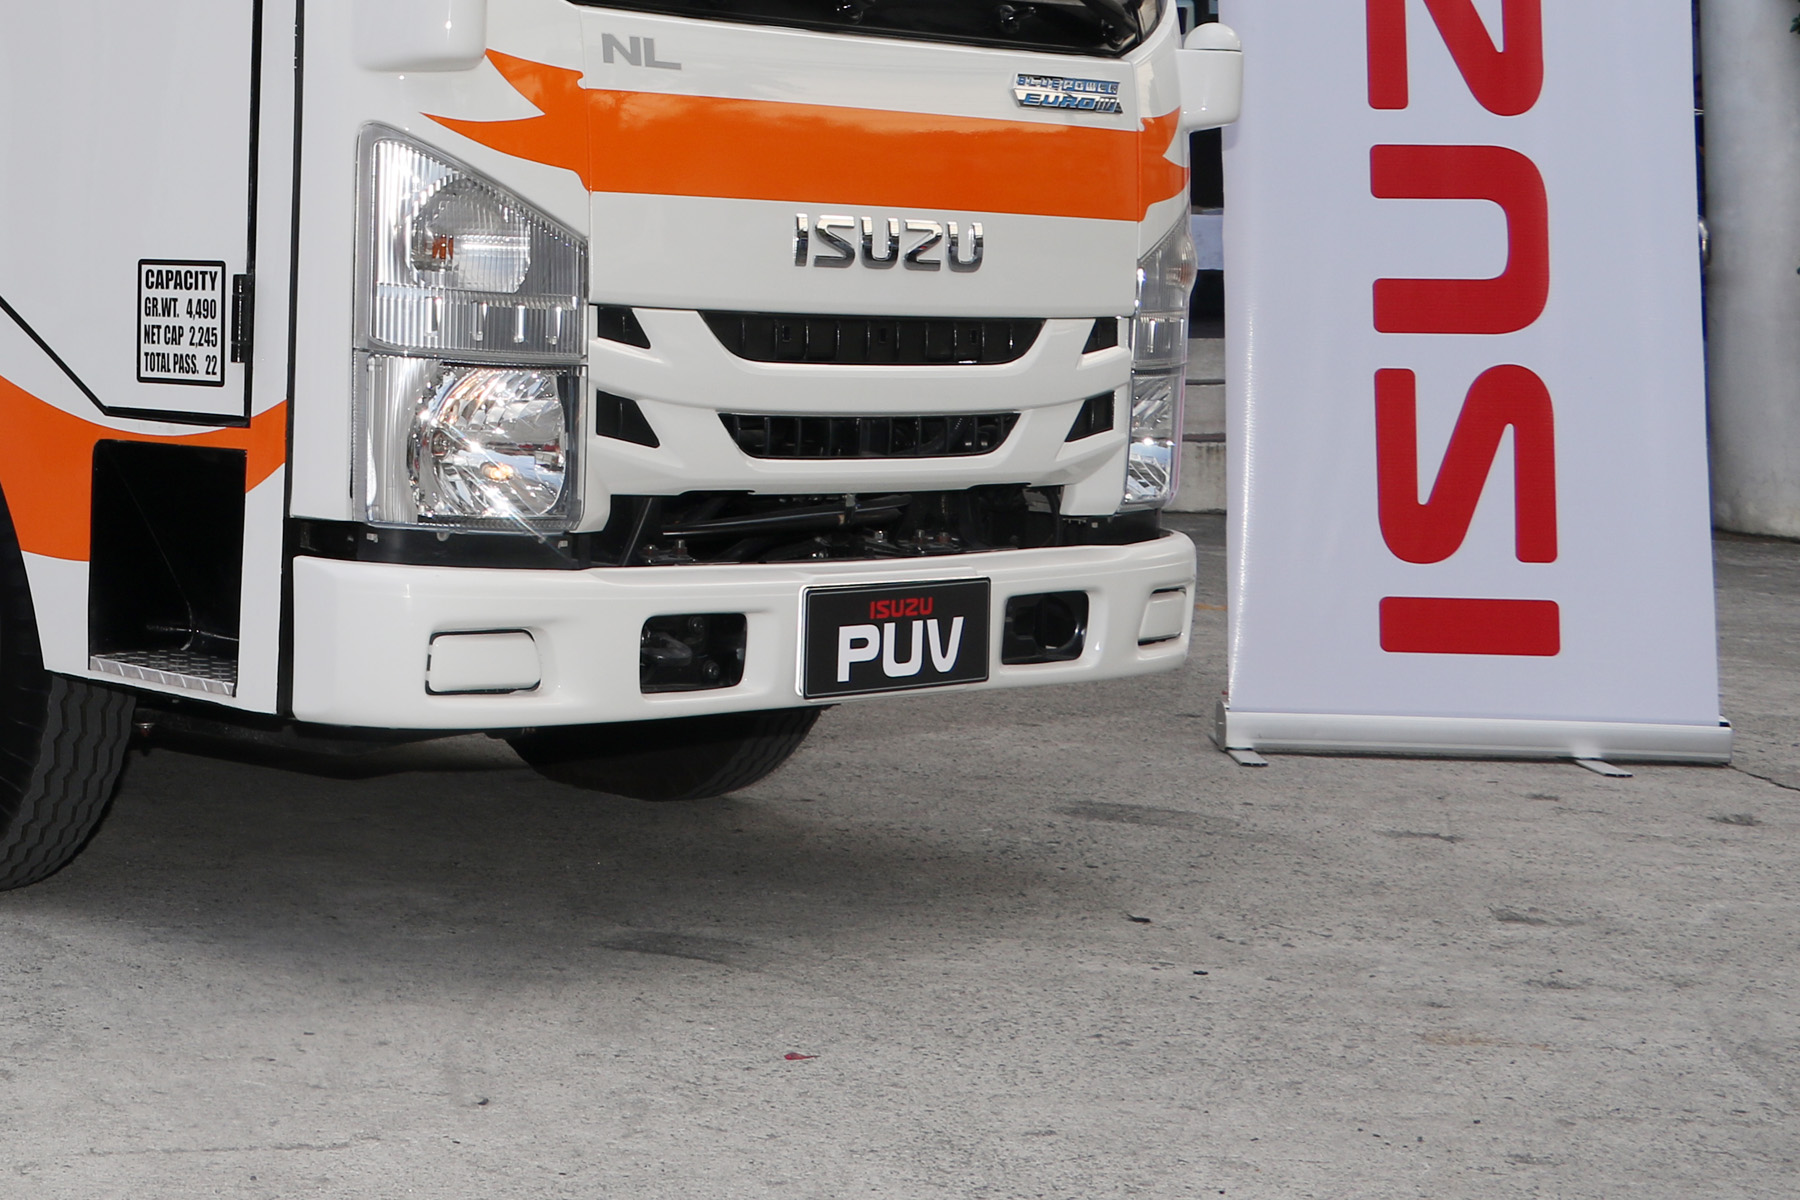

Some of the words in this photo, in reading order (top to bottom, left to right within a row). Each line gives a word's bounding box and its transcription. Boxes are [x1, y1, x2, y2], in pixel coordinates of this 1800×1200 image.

[601, 32, 682, 71] NL
[1023, 92, 1097, 110] EURO
[792, 212, 985, 274] ISUZU
[145, 269, 218, 291] CAPACITY
[144, 296, 180, 318] GR.WT.
[186, 298, 217, 320] 4,490
[144, 324, 162, 345] NET
[164, 324, 185, 346] CAP
[189, 326, 218, 348] 2,245
[144, 352, 171, 373] TOTAL
[173, 353, 199, 375] PASS.
[205, 354, 218, 376] 22
[869, 597, 934, 620] ISUZU
[837, 616, 965, 683] PUV
